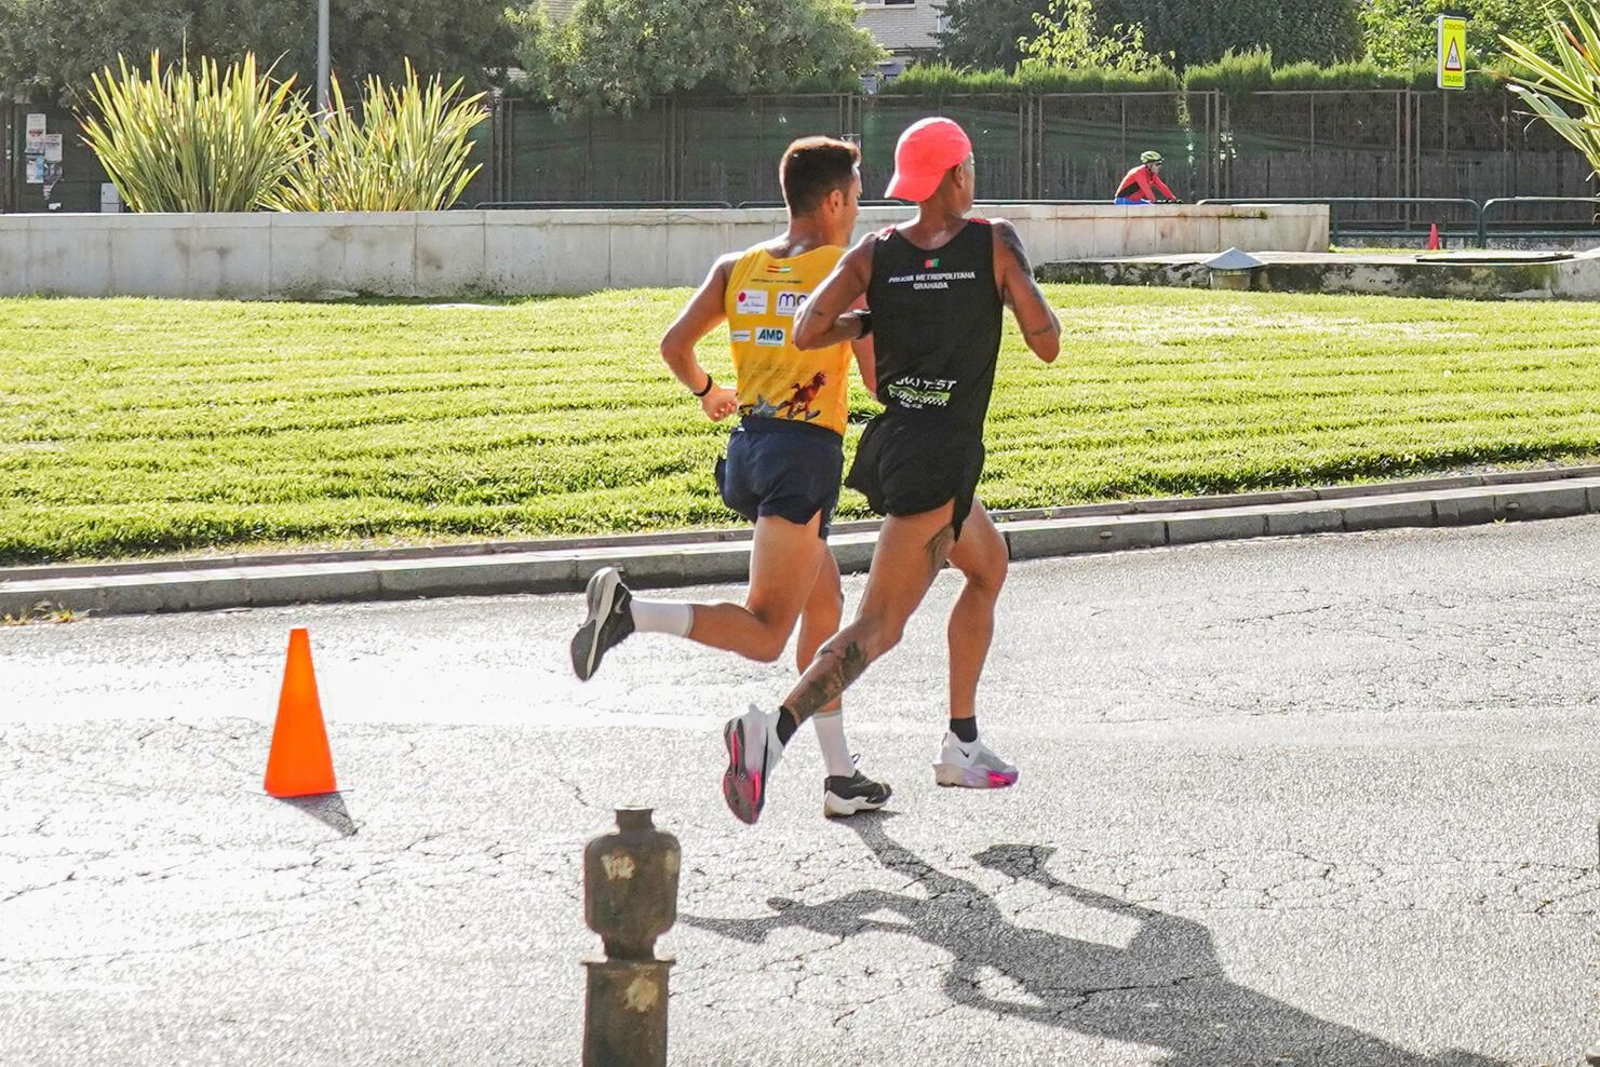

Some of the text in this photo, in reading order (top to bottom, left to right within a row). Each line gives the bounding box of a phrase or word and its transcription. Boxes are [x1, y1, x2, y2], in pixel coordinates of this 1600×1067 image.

[916, 271, 976, 282] METROPOLITANA
[913, 282, 950, 290] GRANADA
[757, 328, 784, 341] AMD
